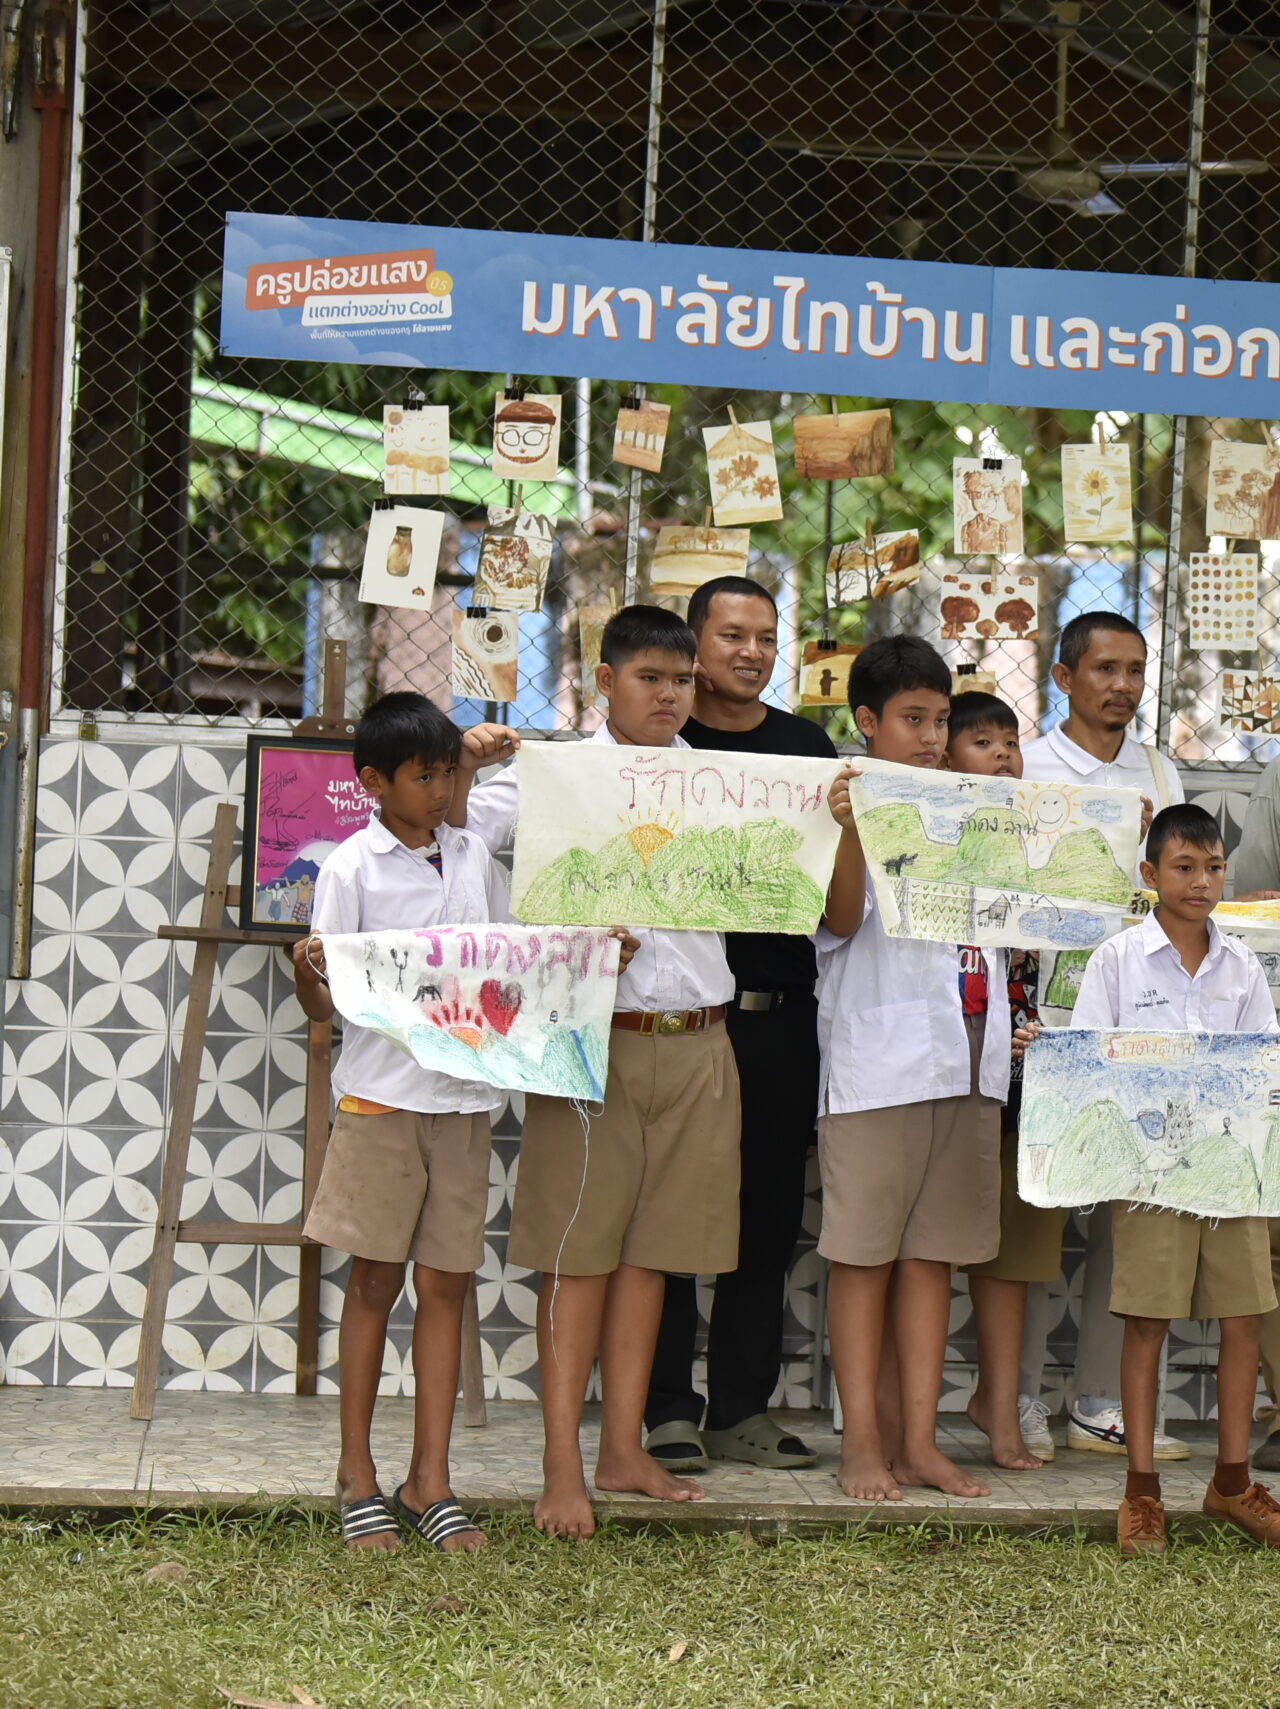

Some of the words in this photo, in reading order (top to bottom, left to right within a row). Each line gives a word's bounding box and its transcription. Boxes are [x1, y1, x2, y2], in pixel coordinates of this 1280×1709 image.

[256, 259, 428, 305] ครูปล่อยแสง
[308, 299, 407, 319] แตกต่างอย่าง
[409, 300, 445, 316] Cool
[521, 273, 986, 365] มหา'ลัยไทบ้าน
